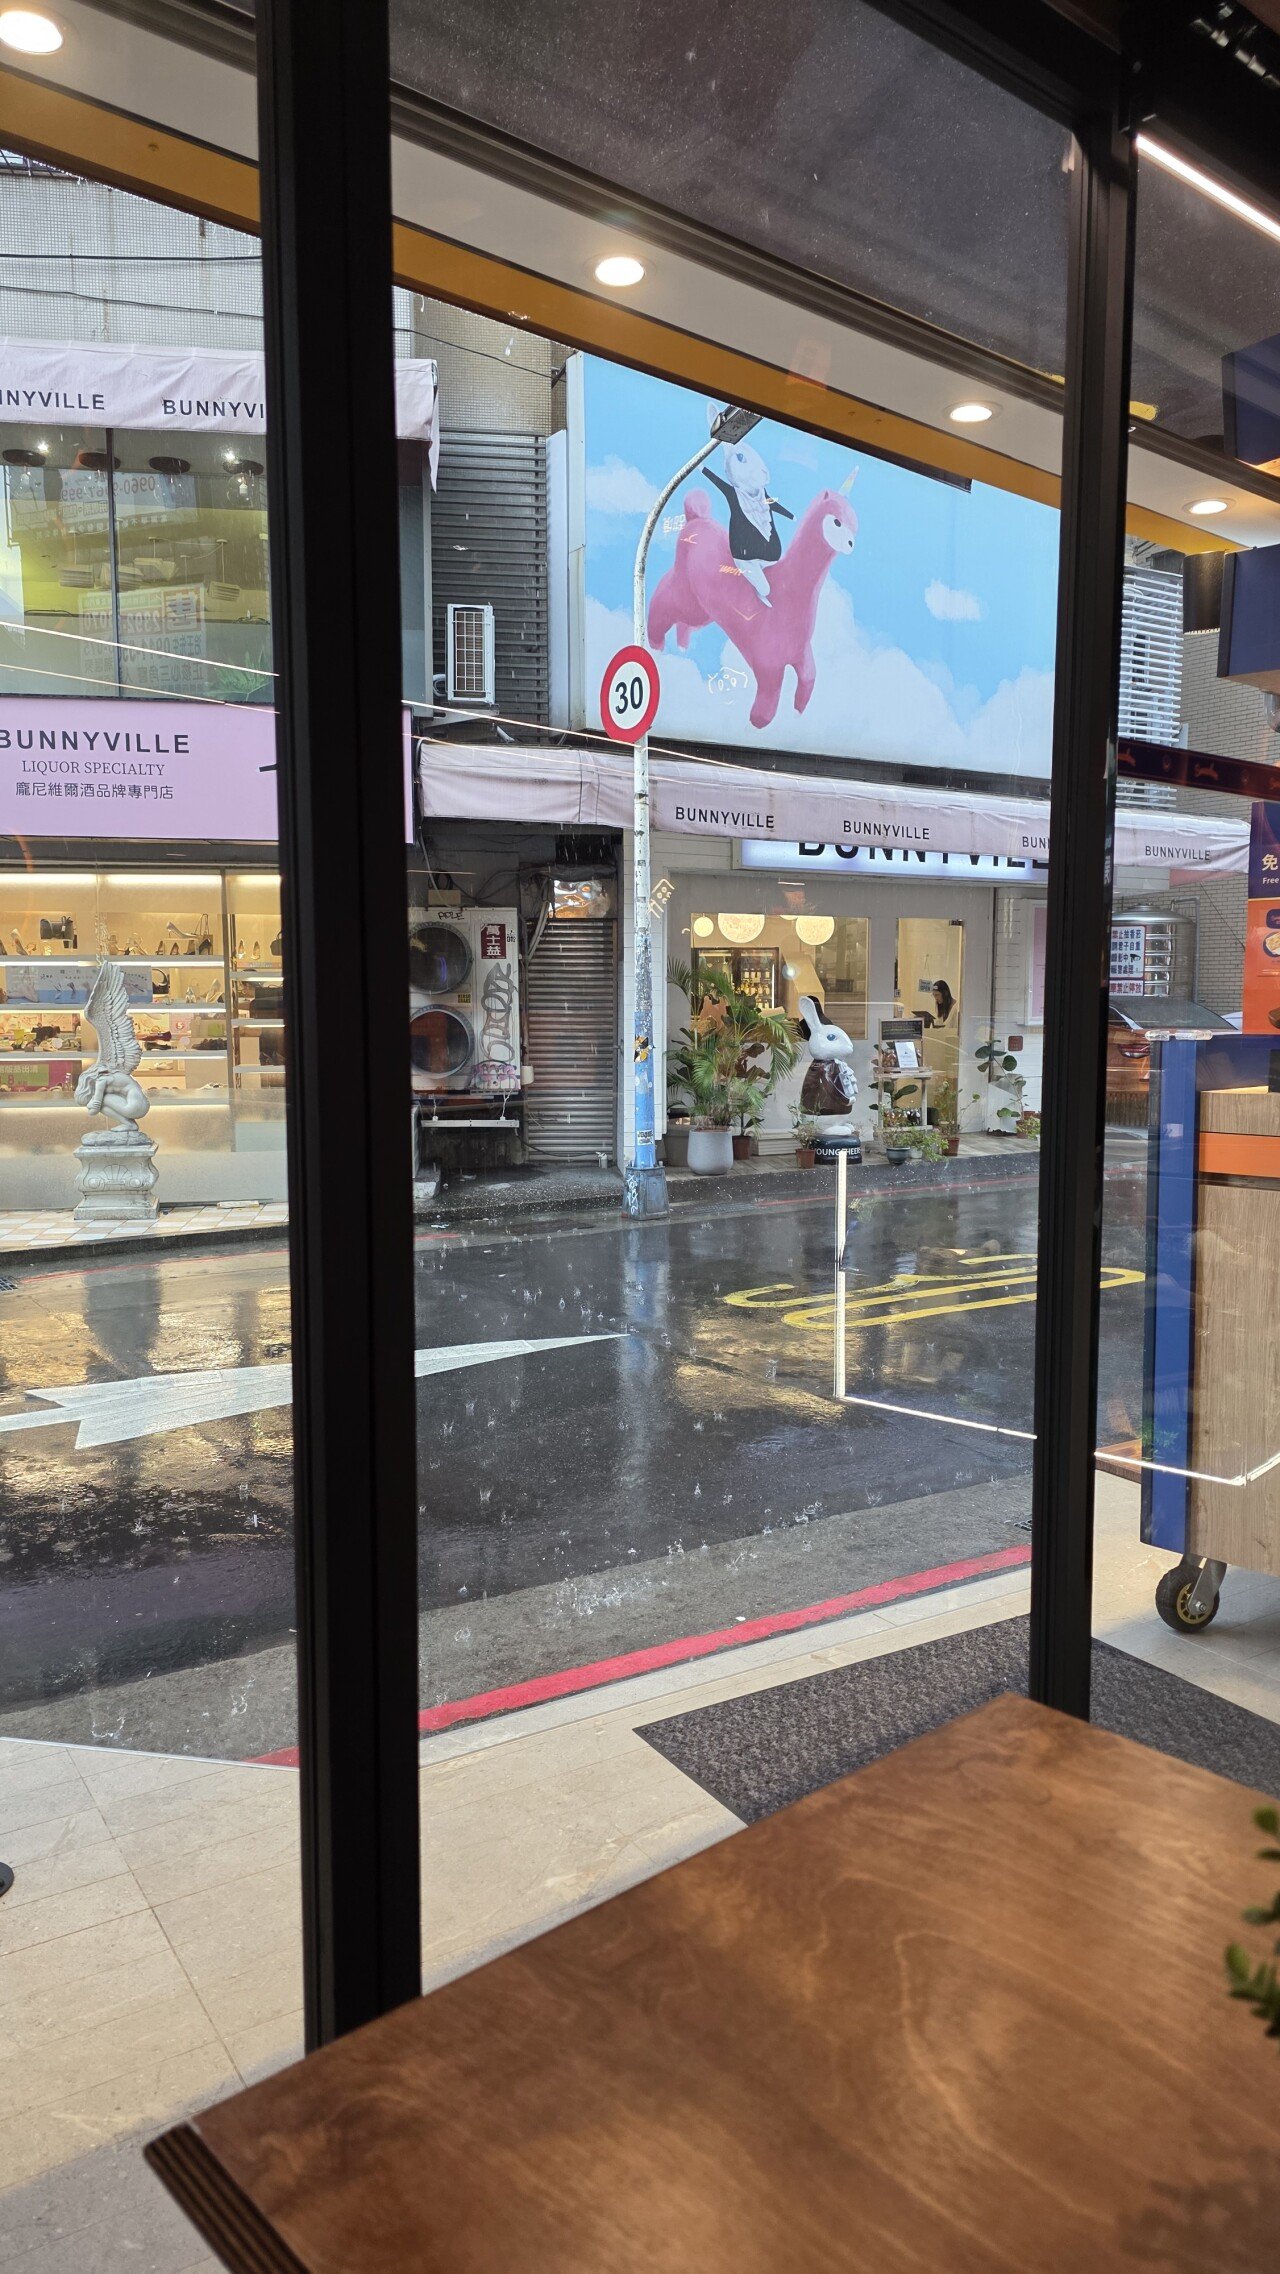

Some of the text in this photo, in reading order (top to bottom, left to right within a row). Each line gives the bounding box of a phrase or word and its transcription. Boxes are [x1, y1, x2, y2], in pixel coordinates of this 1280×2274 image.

[0, 389, 105, 410] NYVILLE
[163, 399, 264, 418] BUNNYVI
[615, 676, 644, 714] 30
[0, 729, 190, 754] BUNNYVILLE
[22, 760, 165, 776] LIQUOR SPECIALTY
[675, 806, 775, 829] BUNNYVILLE
[843, 820, 930, 840] BUNNYVILLE
[1022, 836, 1049, 850] BUN
[1145, 845, 1211, 861] BUNNYVILLE
[1262, 853, 1279, 871] 免
[1262, 877, 1280, 886] Free
